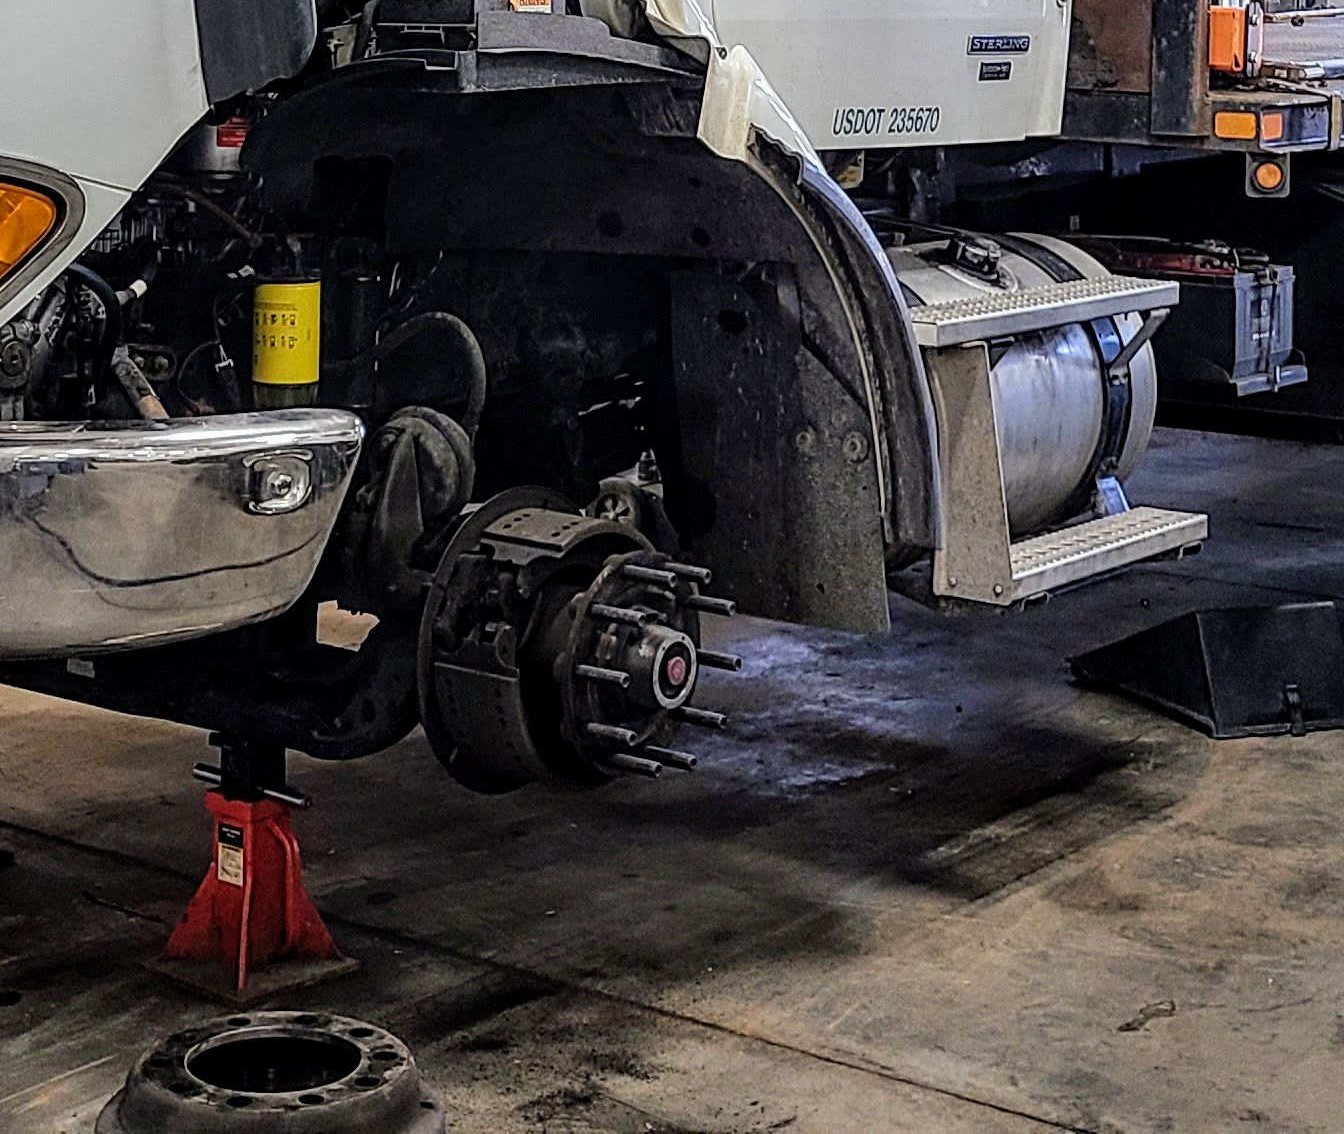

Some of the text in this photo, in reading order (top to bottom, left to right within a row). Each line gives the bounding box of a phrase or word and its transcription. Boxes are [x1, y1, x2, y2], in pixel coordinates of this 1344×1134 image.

[972, 38, 1029, 50] STERLING
[832, 106, 941, 136] USDOT 235670
